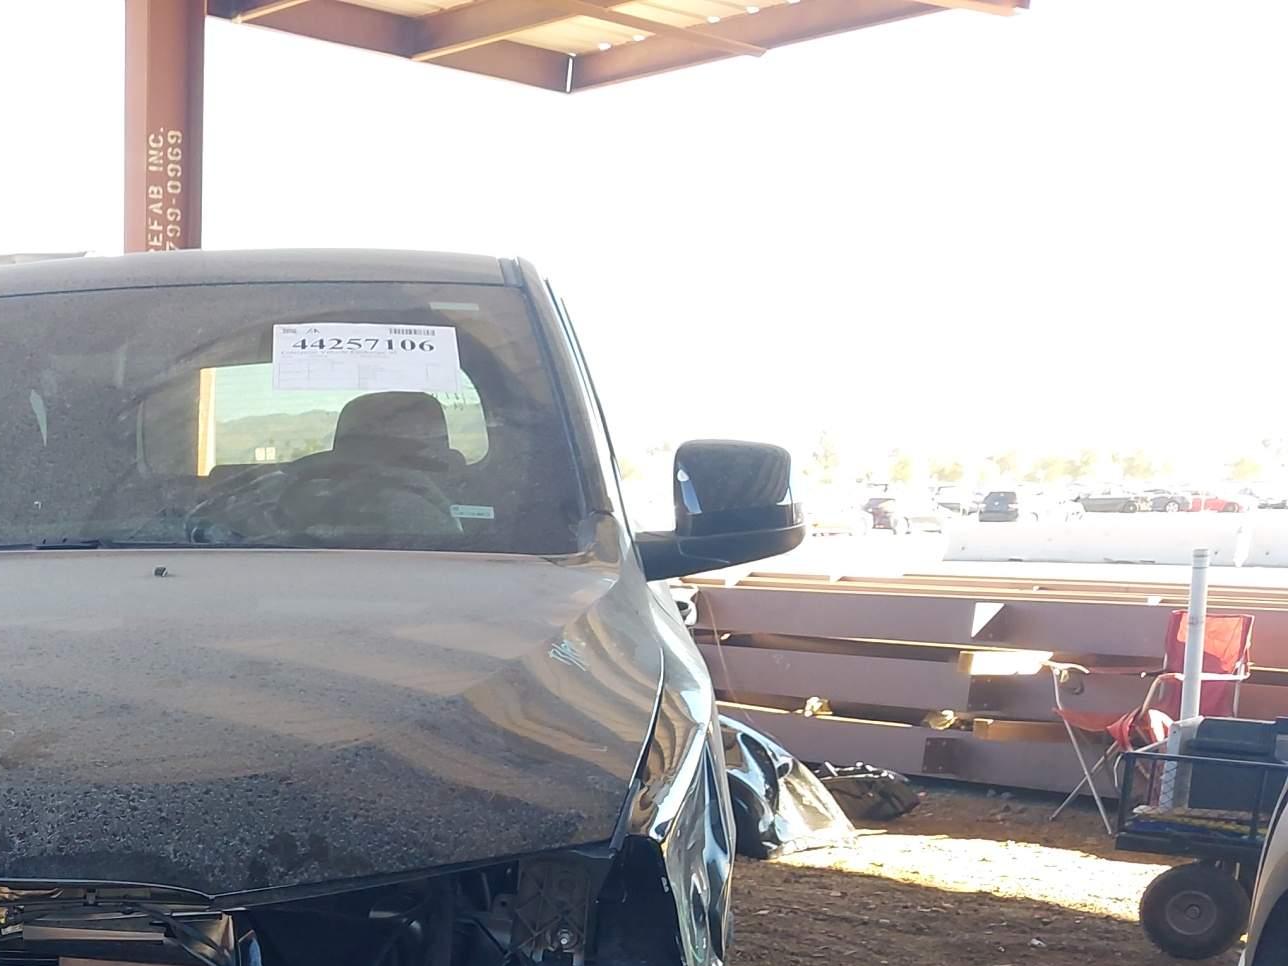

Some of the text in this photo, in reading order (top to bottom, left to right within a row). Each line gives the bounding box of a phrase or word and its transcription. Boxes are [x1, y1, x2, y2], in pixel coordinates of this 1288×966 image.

[148, 127, 165, 252] EFAB INC.
[291, 337, 436, 352] 44257106
